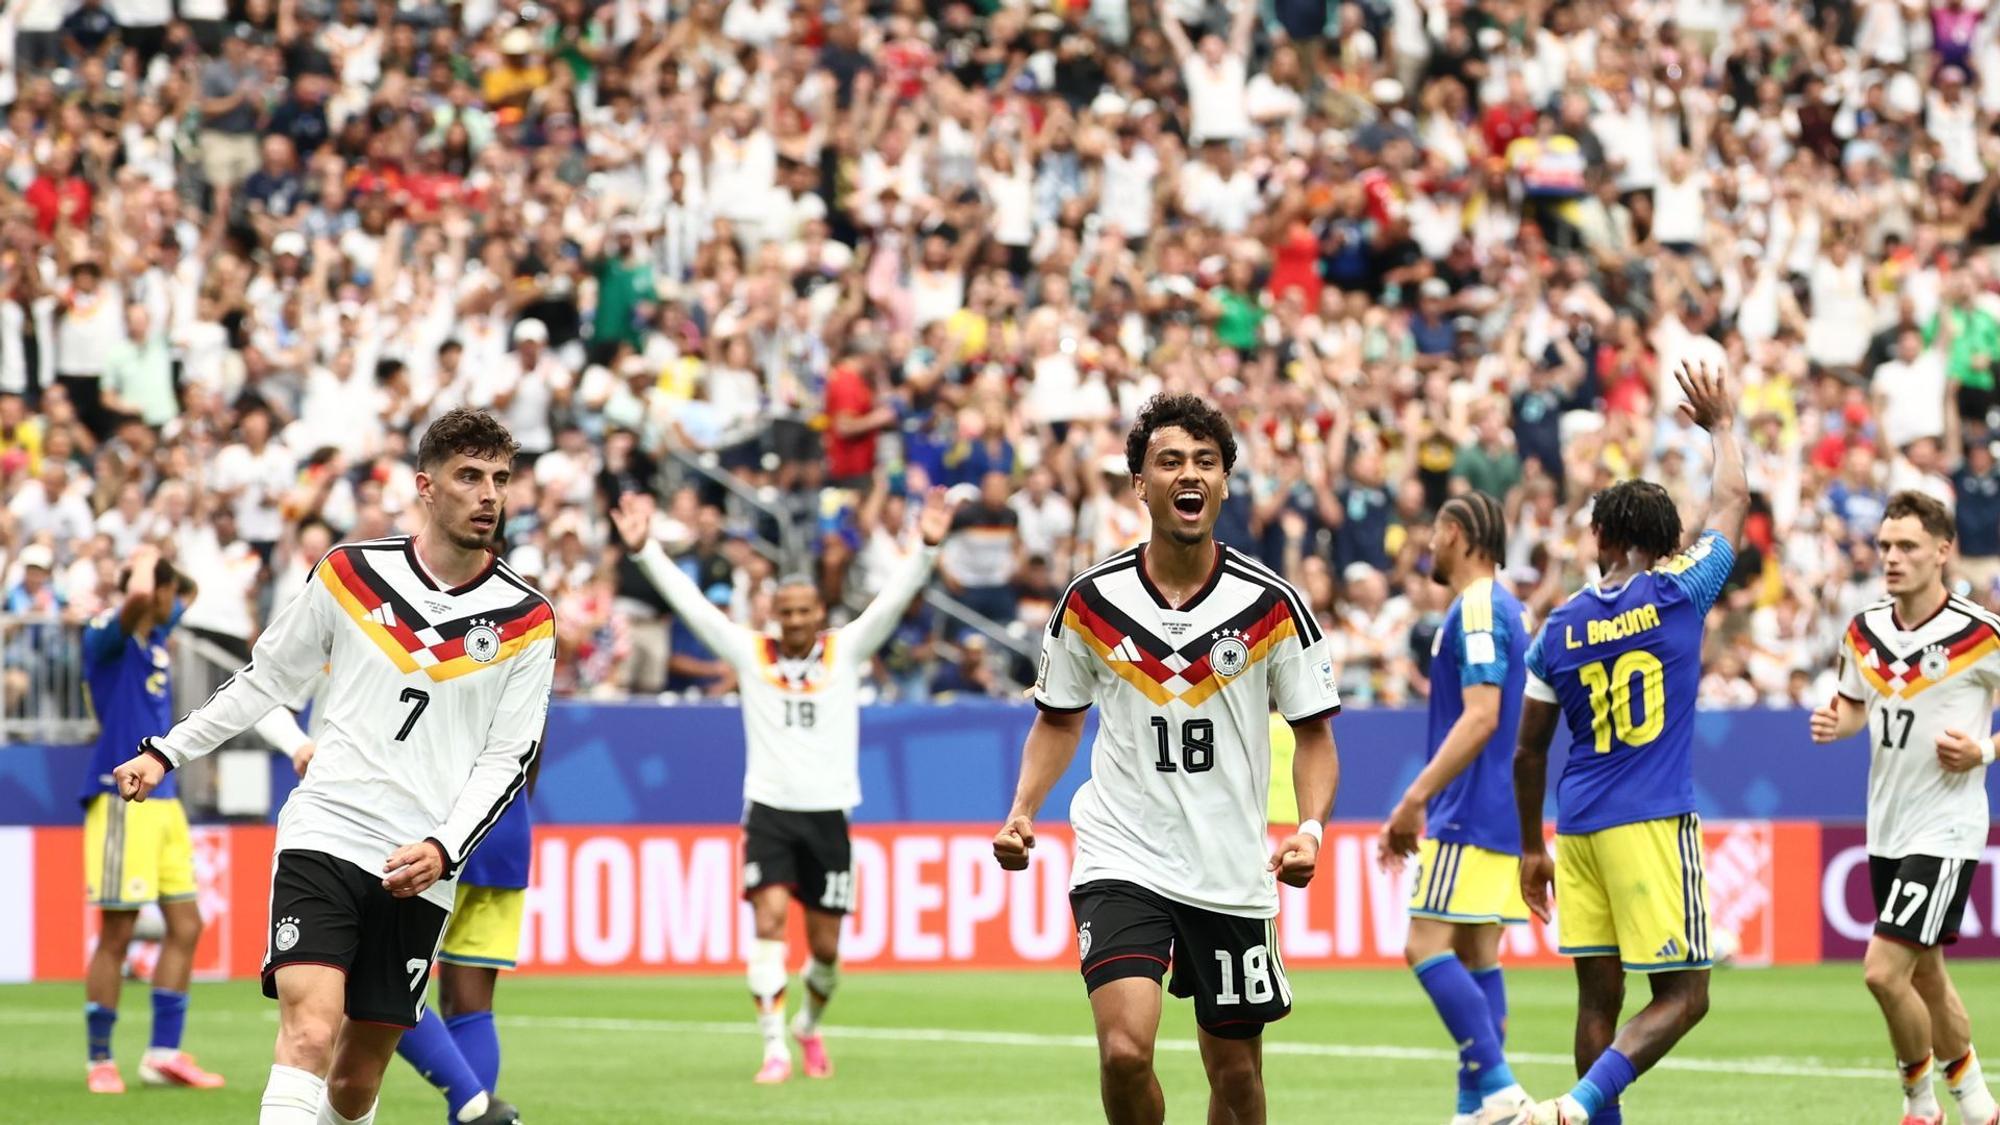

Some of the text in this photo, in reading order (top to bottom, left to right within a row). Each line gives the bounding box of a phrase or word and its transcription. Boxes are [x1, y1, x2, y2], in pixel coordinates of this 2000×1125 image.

[1566, 603, 1660, 650] L. BACUNA
[394, 687, 430, 741] 7
[1578, 650, 1665, 753] 10
[1881, 706, 1915, 749] 17
[1151, 716, 1214, 774] 18
[517, 836, 756, 964] HOM
[838, 836, 1072, 962] DEPO
[1880, 878, 1928, 927] 17
[1215, 944, 1274, 1005] 18
